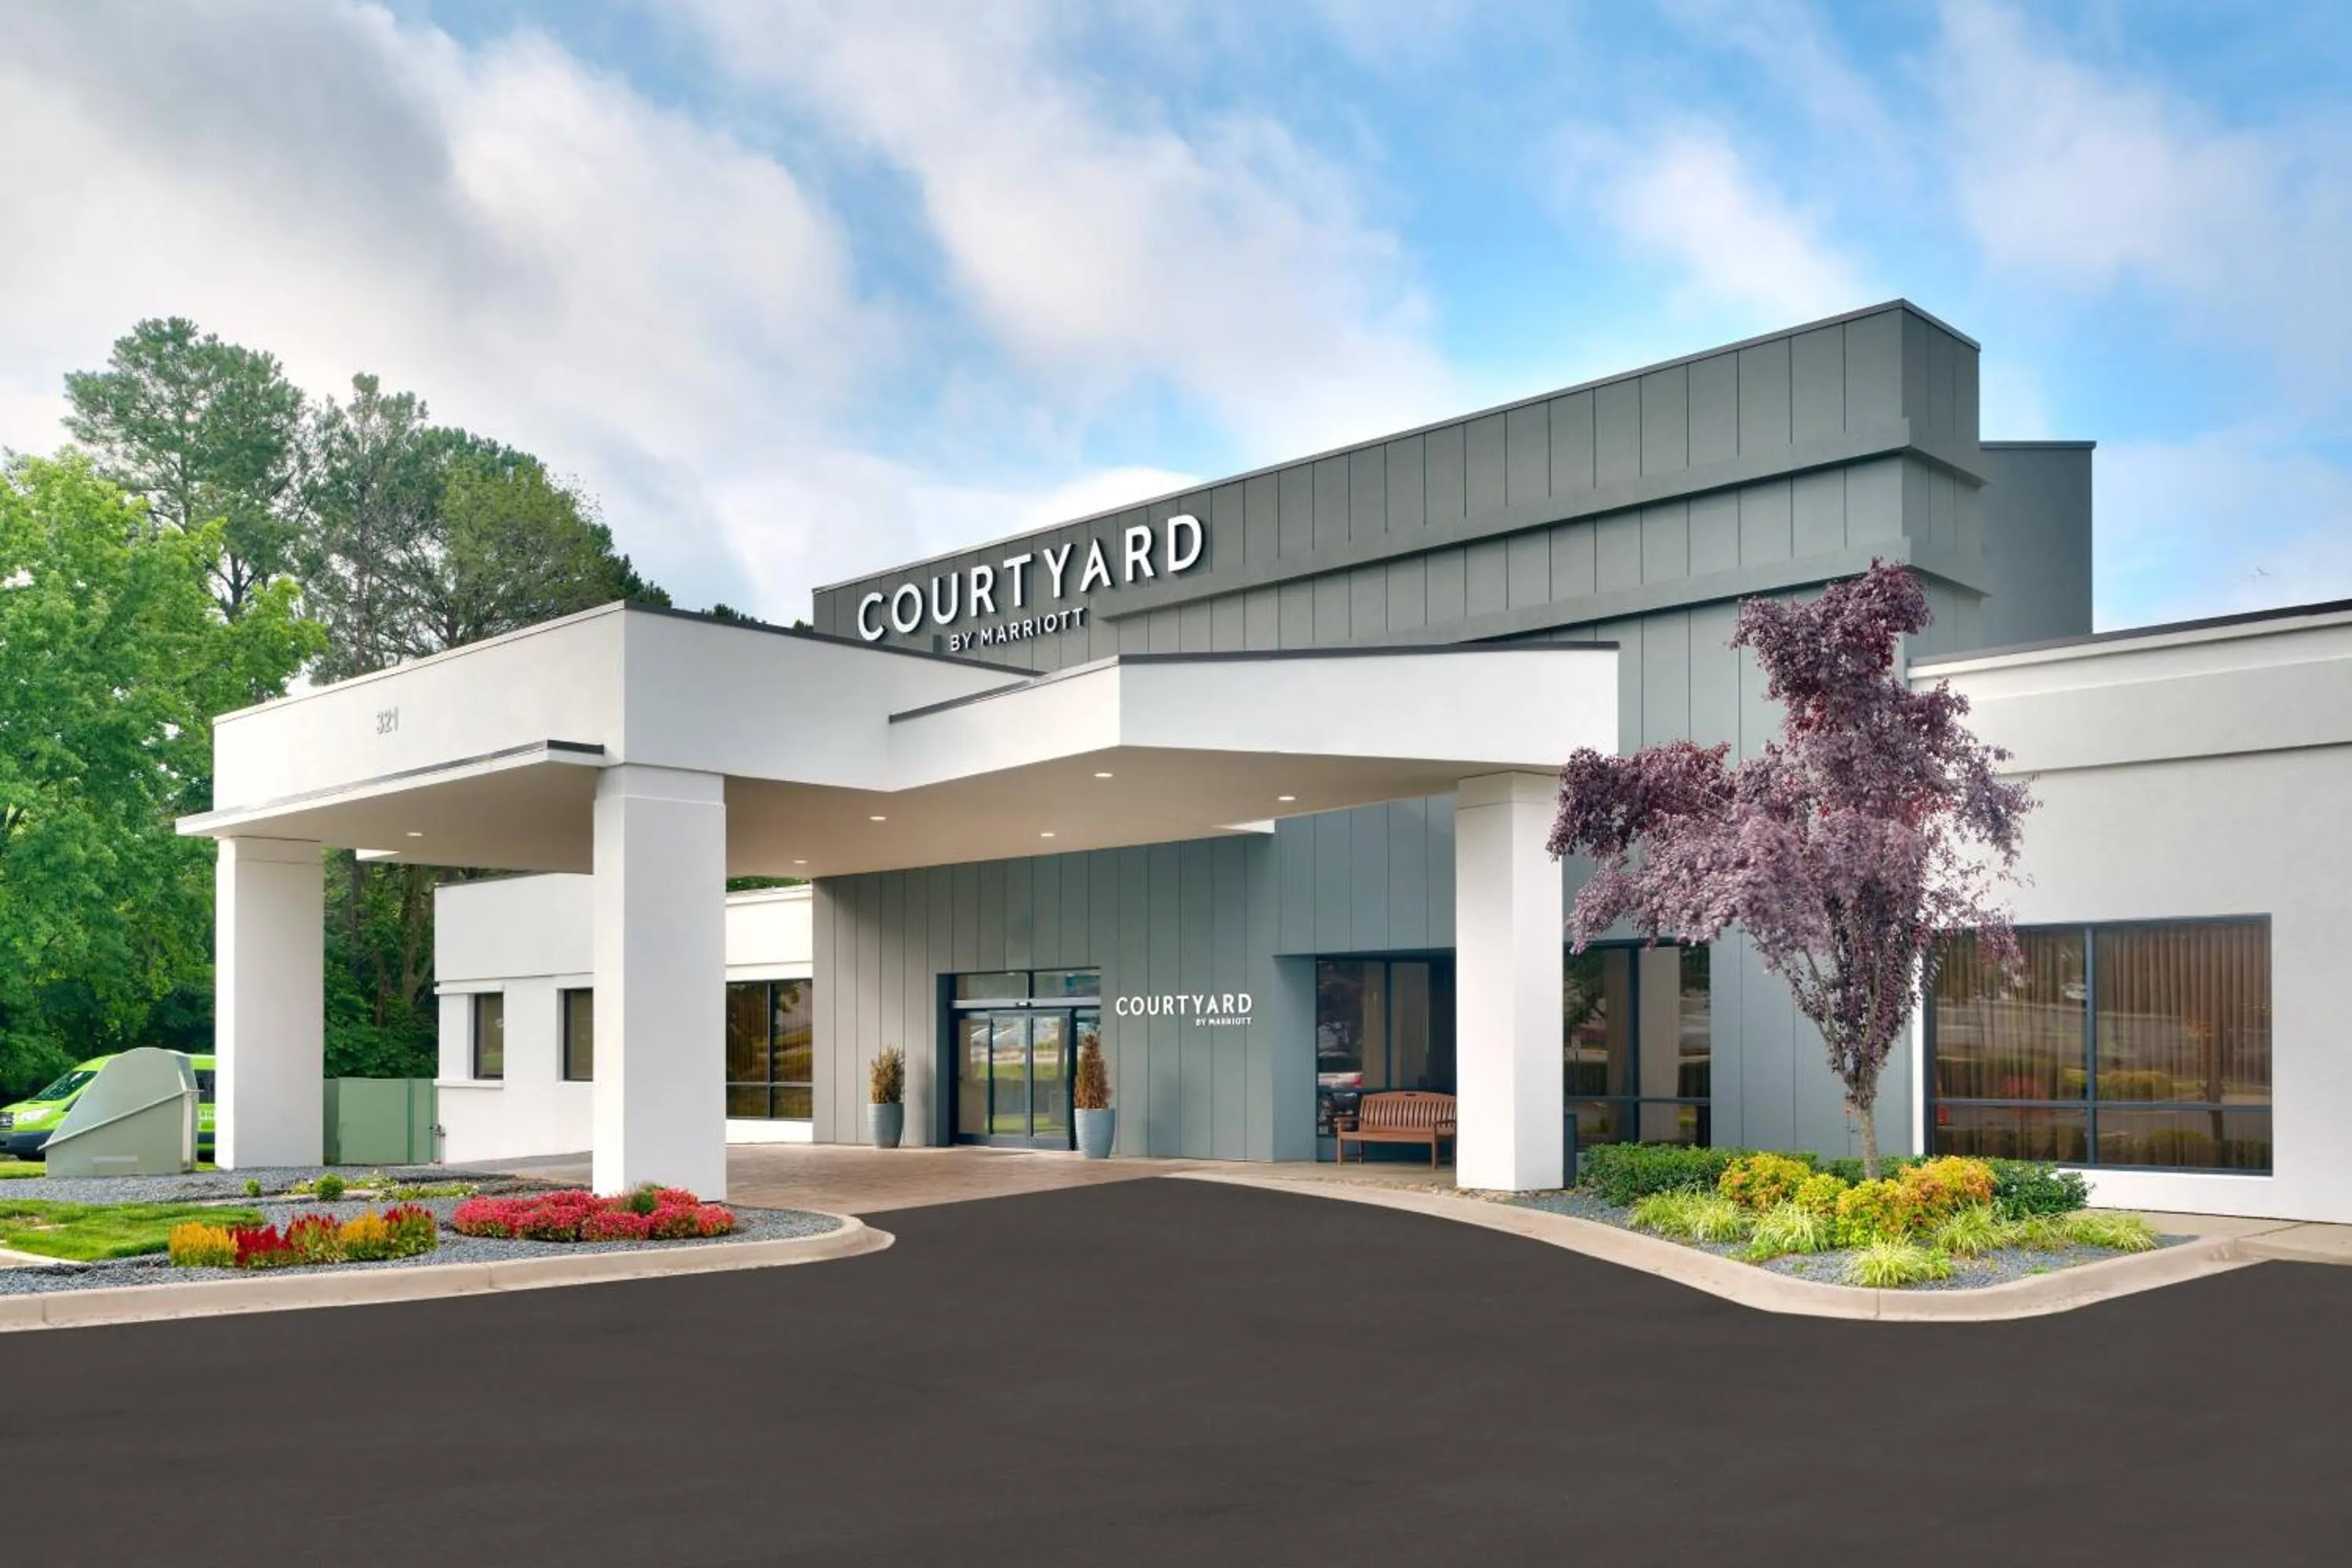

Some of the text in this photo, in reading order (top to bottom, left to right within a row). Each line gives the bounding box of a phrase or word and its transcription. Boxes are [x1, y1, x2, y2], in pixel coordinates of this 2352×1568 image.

[857, 514, 1203, 641] COURTYARD
[950, 608, 1085, 652] BY MARRIOTT
[376, 706, 399, 734] 321
[1116, 993, 1252, 1016] COURTYARD
